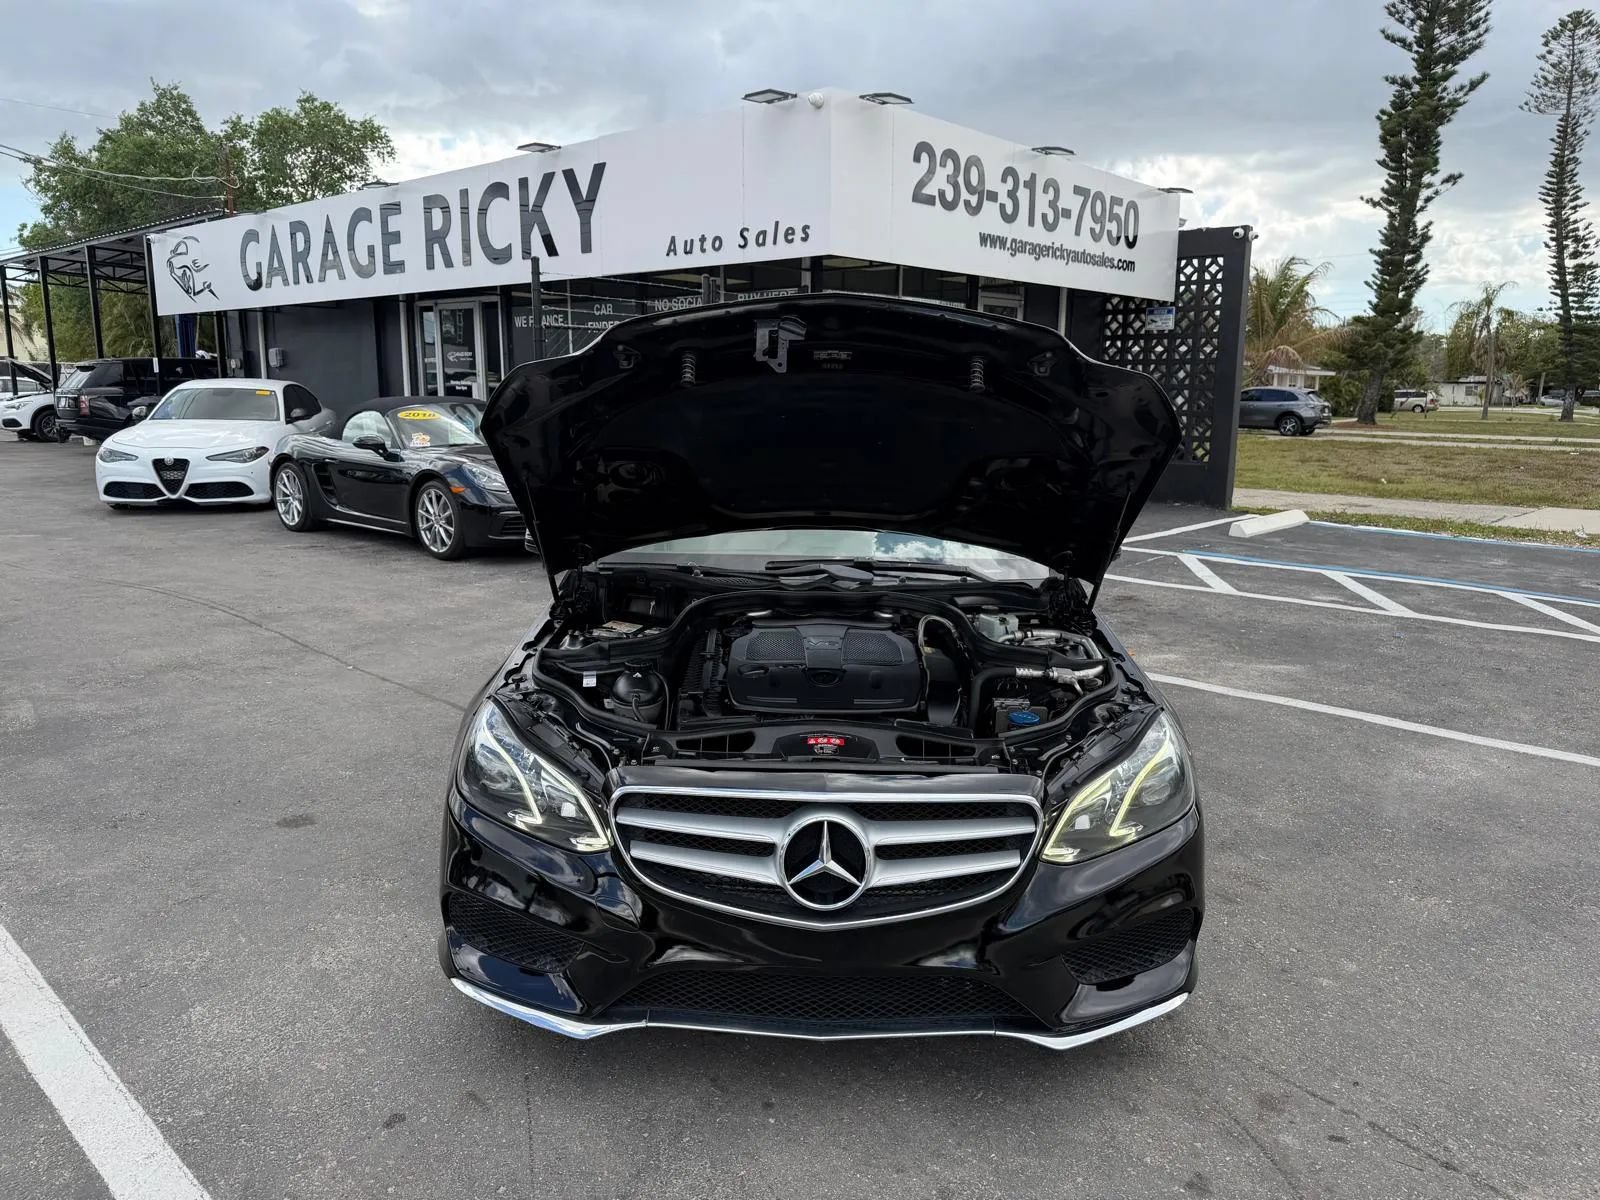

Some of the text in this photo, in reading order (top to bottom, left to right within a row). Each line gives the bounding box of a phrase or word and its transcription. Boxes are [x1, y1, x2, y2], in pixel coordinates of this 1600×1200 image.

[911, 140, 1140, 250] 239-313-7950
[239, 161, 606, 291] GARAGE RICKY
[665, 220, 811, 257] Auto Sales
[978, 231, 1136, 273] www.garagerickyautosales.com
[514, 315, 528, 328] WE
[593, 303, 614, 316] CAR
[655, 296, 703, 312] NO SOCIA
